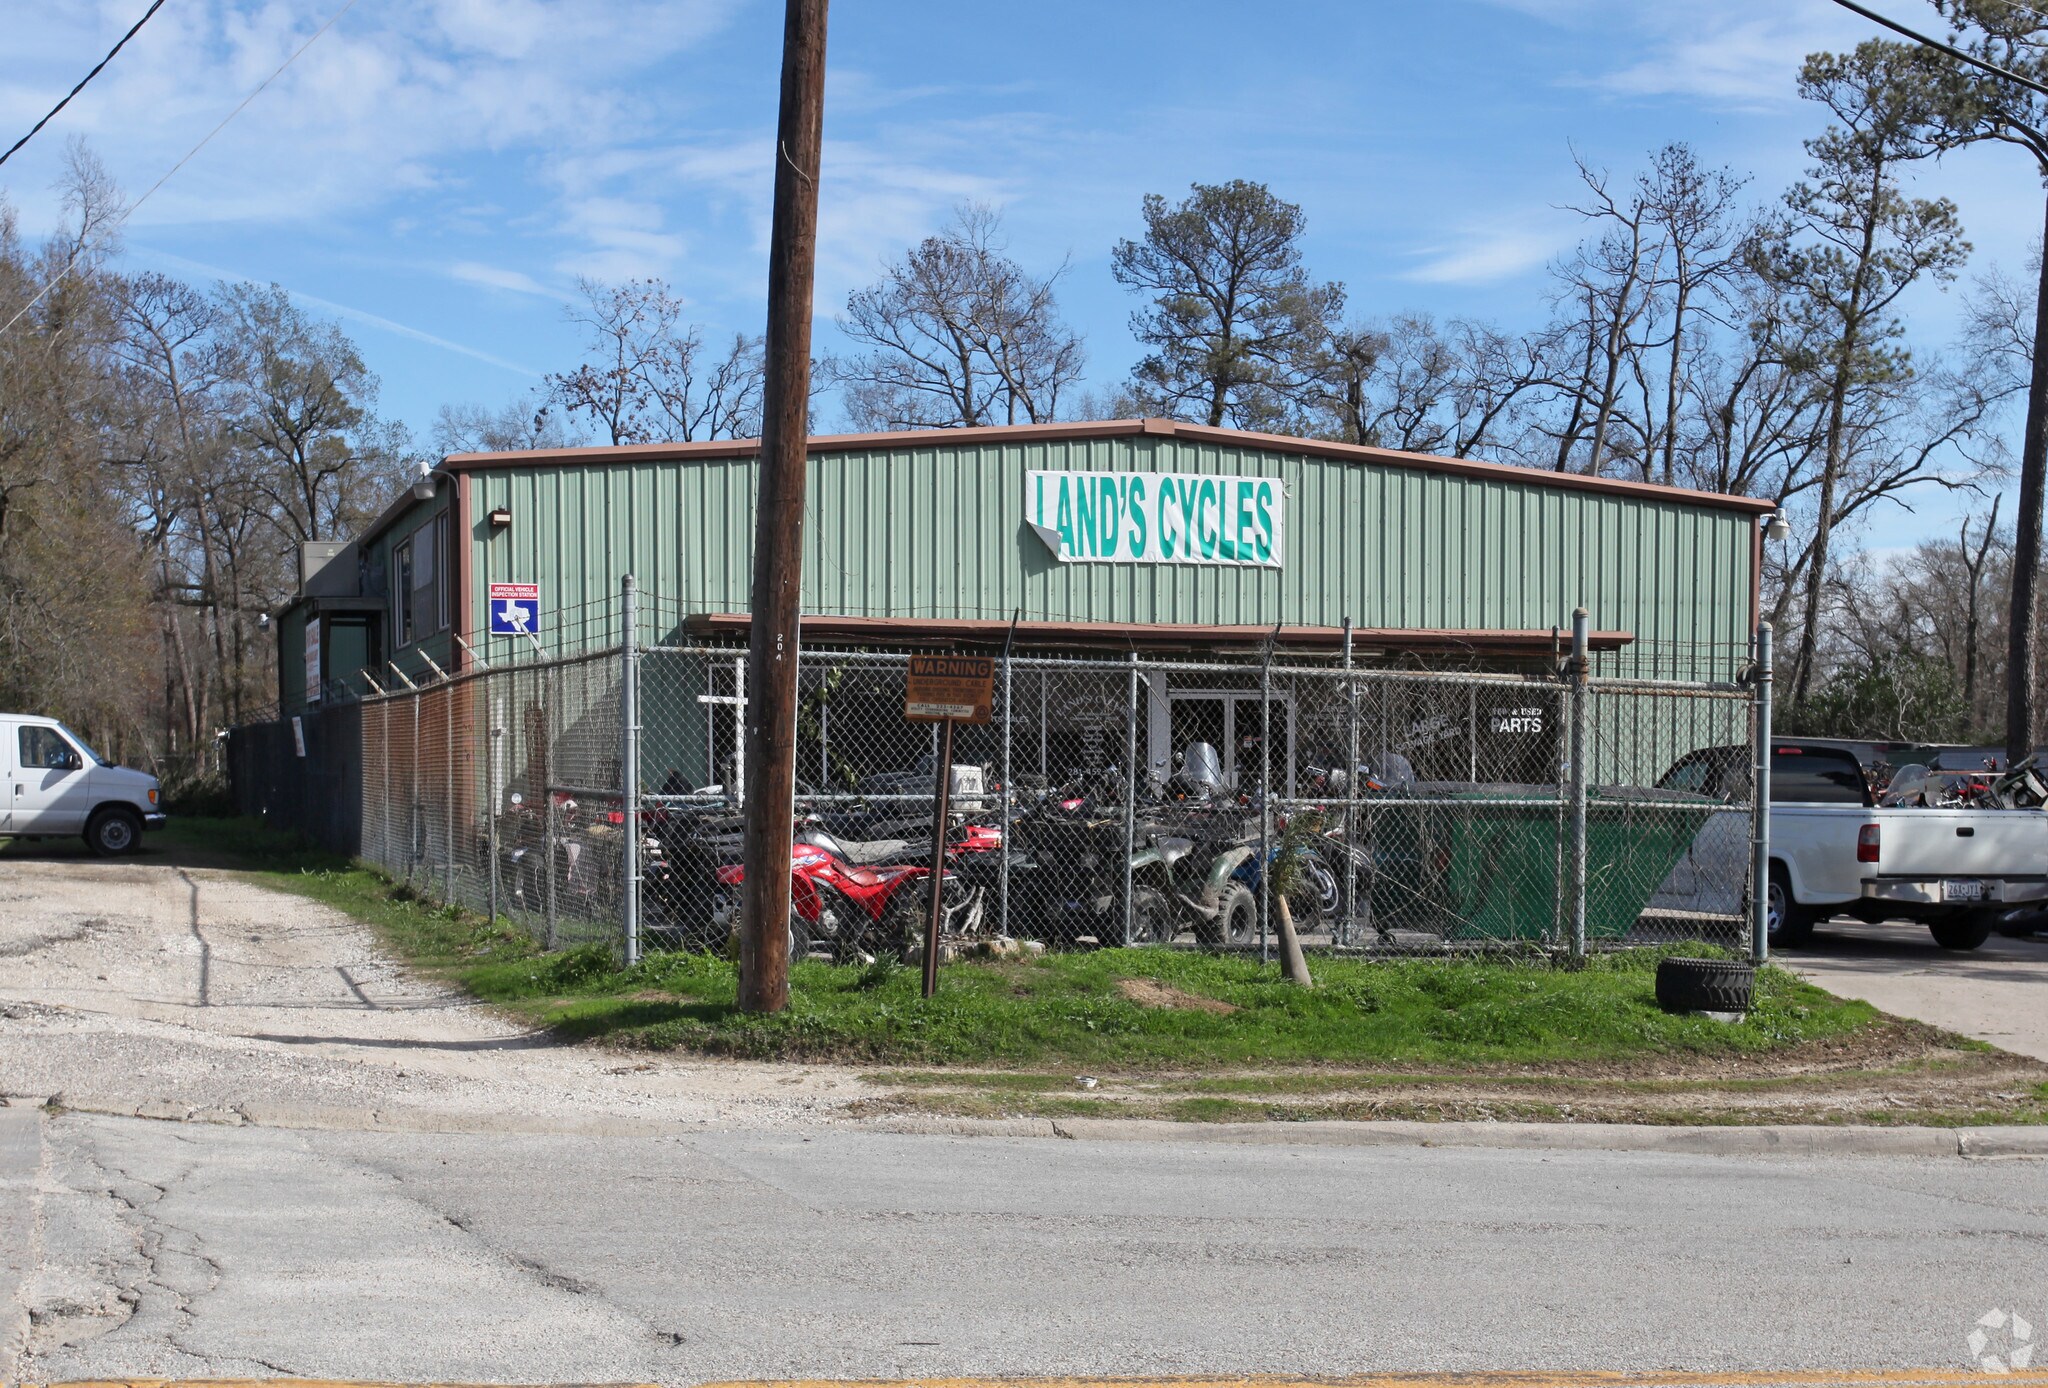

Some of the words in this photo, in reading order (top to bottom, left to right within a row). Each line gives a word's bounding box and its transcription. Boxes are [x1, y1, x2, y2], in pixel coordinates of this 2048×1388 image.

[1158, 477, 1273, 562] CYCLES
[914, 660, 989, 676] WARNING
[1520, 707, 1542, 715] USED
[1403, 714, 1448, 737] LARGE
[1491, 717, 1542, 733] PARTS
